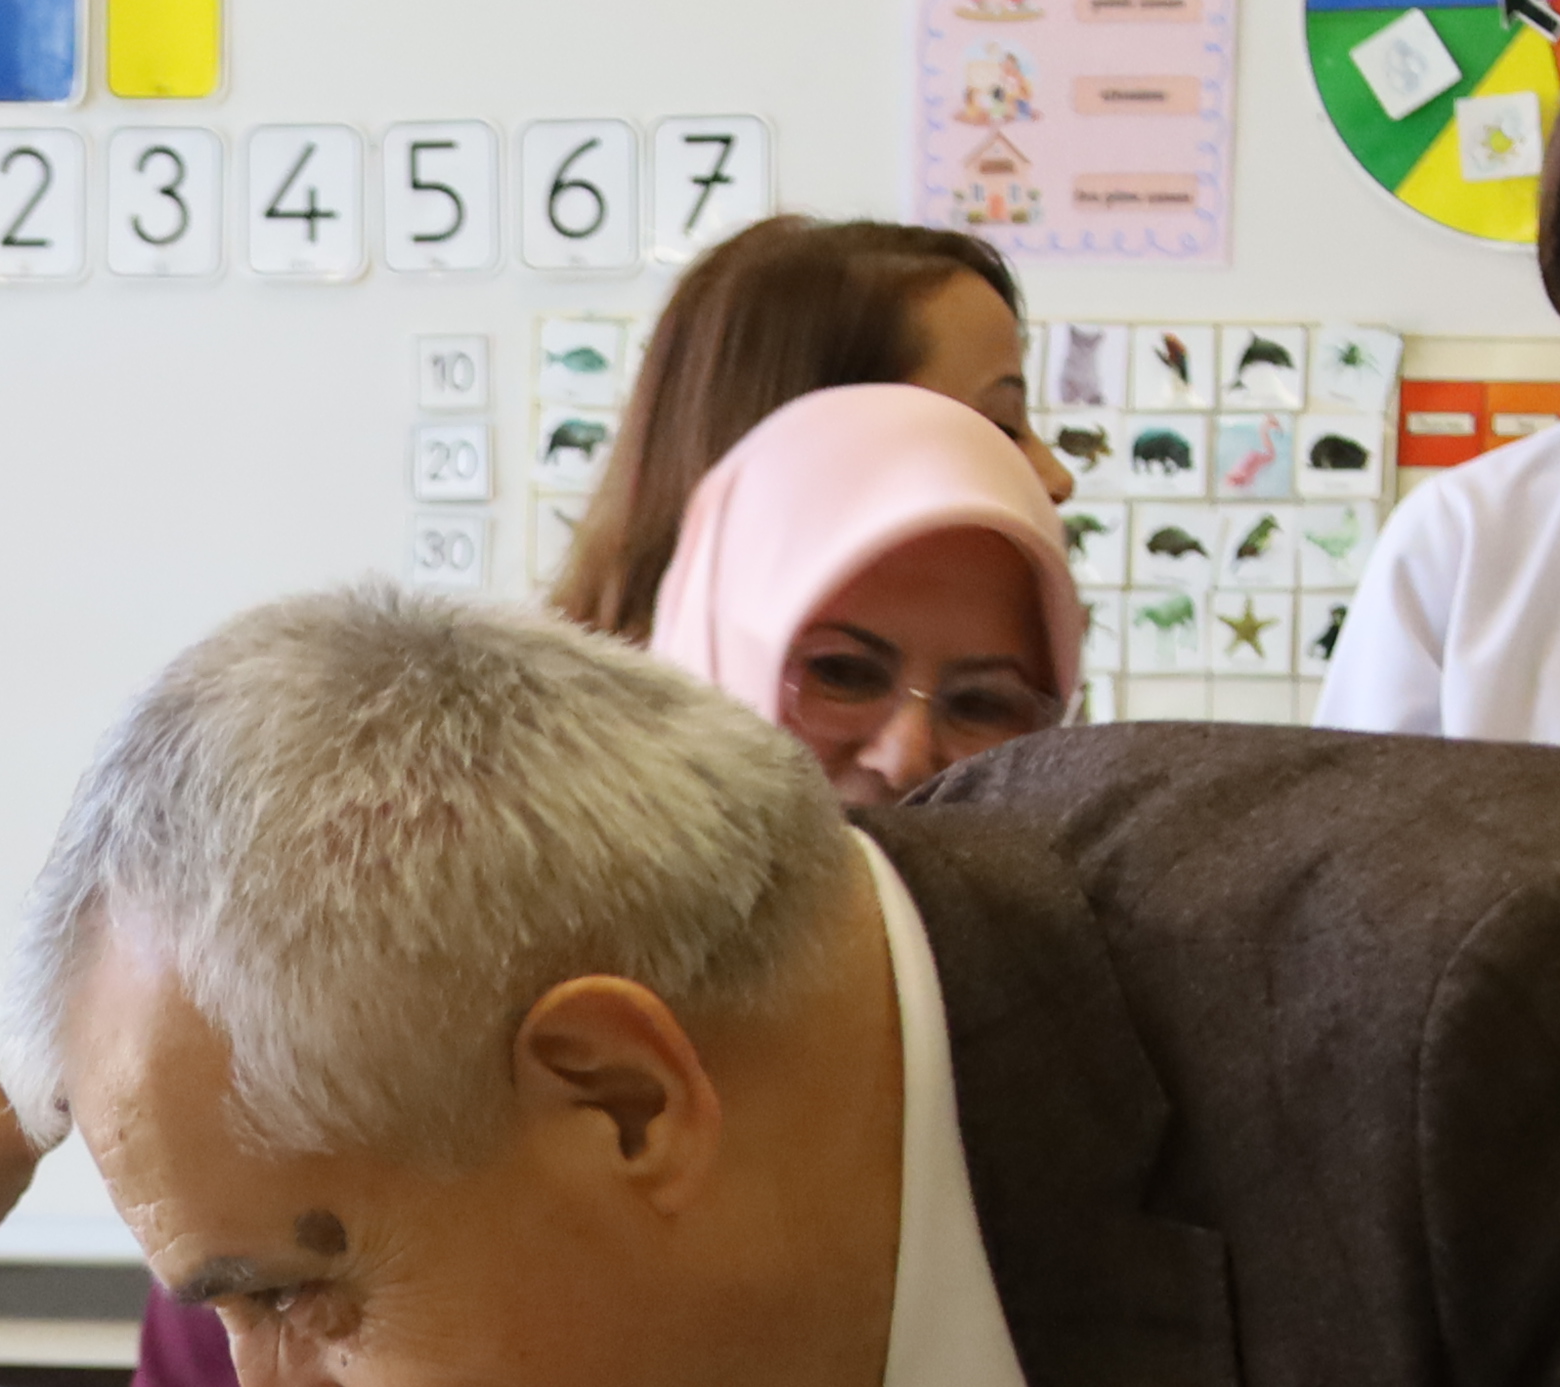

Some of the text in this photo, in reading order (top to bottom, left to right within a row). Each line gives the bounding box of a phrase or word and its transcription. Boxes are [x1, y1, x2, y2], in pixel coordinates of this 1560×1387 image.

[0, 145, 54, 248] 2
[131, 145, 191, 246] 3
[263, 141, 338, 243] 4
[407, 139, 465, 243] 5
[547, 137, 607, 240] 6
[683, 133, 736, 236] 7
[429, 351, 476, 393] 10
[425, 439, 479, 482] 20
[422, 529, 476, 572] 30
